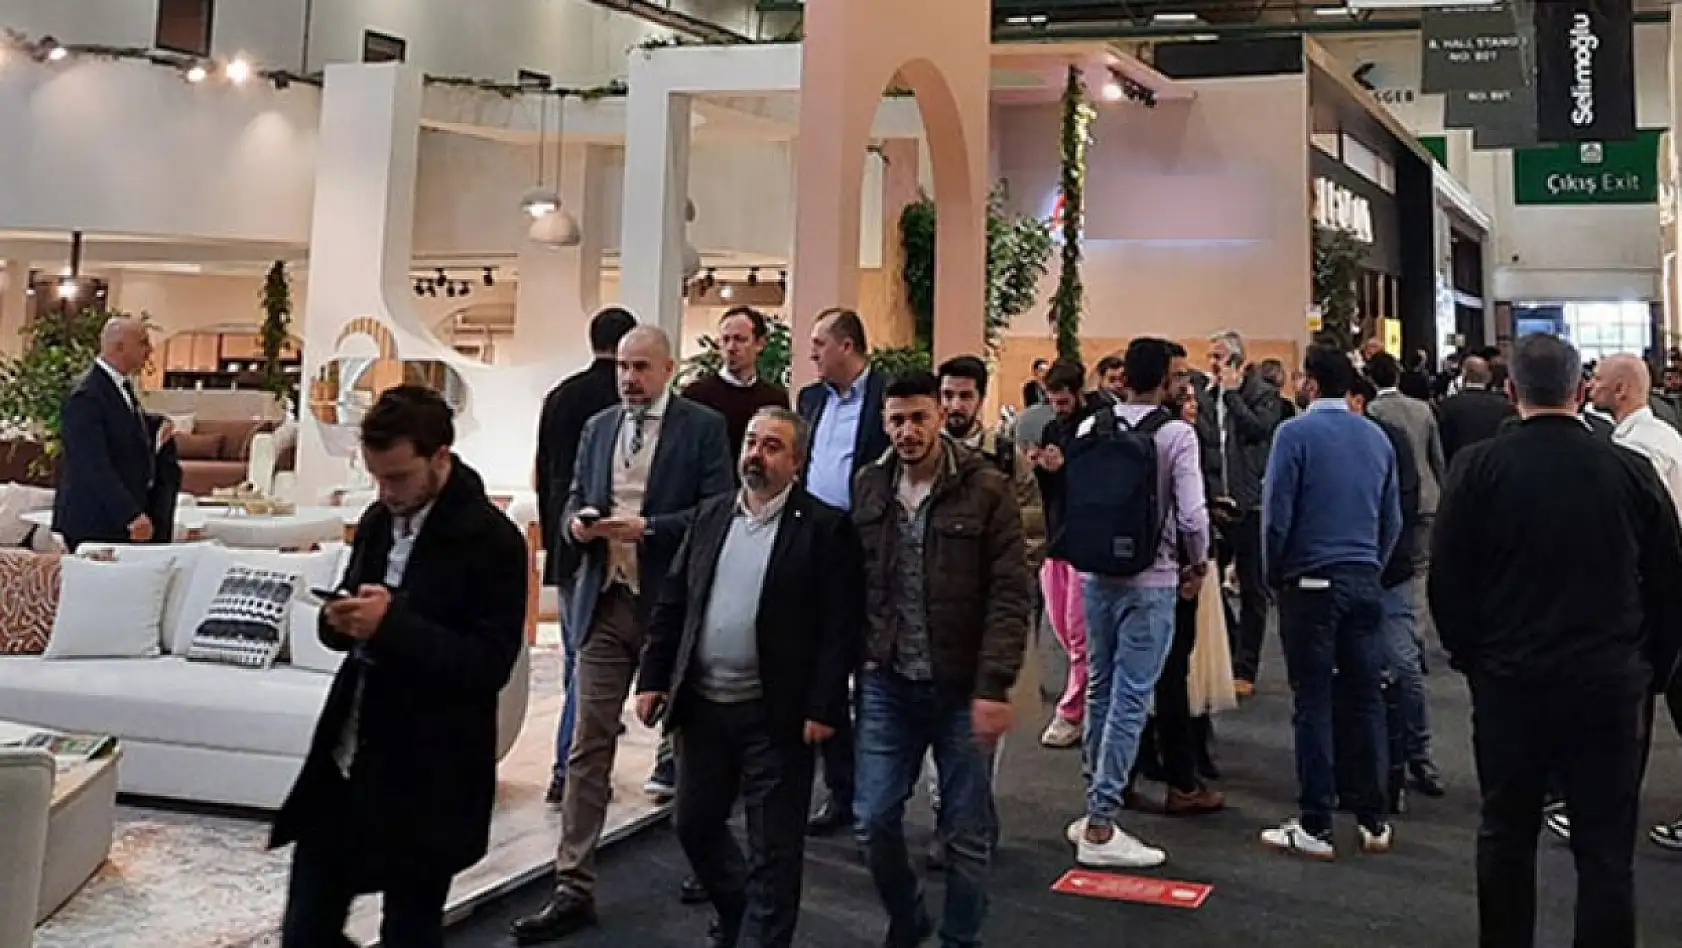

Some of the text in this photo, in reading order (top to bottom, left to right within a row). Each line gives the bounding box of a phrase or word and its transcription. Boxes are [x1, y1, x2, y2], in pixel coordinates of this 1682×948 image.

[1442, 38, 1474, 49] HALL
[1476, 36, 1519, 48] STAND
[1569, 13, 1599, 124] Selimoğlu
[1547, 172, 1640, 195] Çıkış Exit
